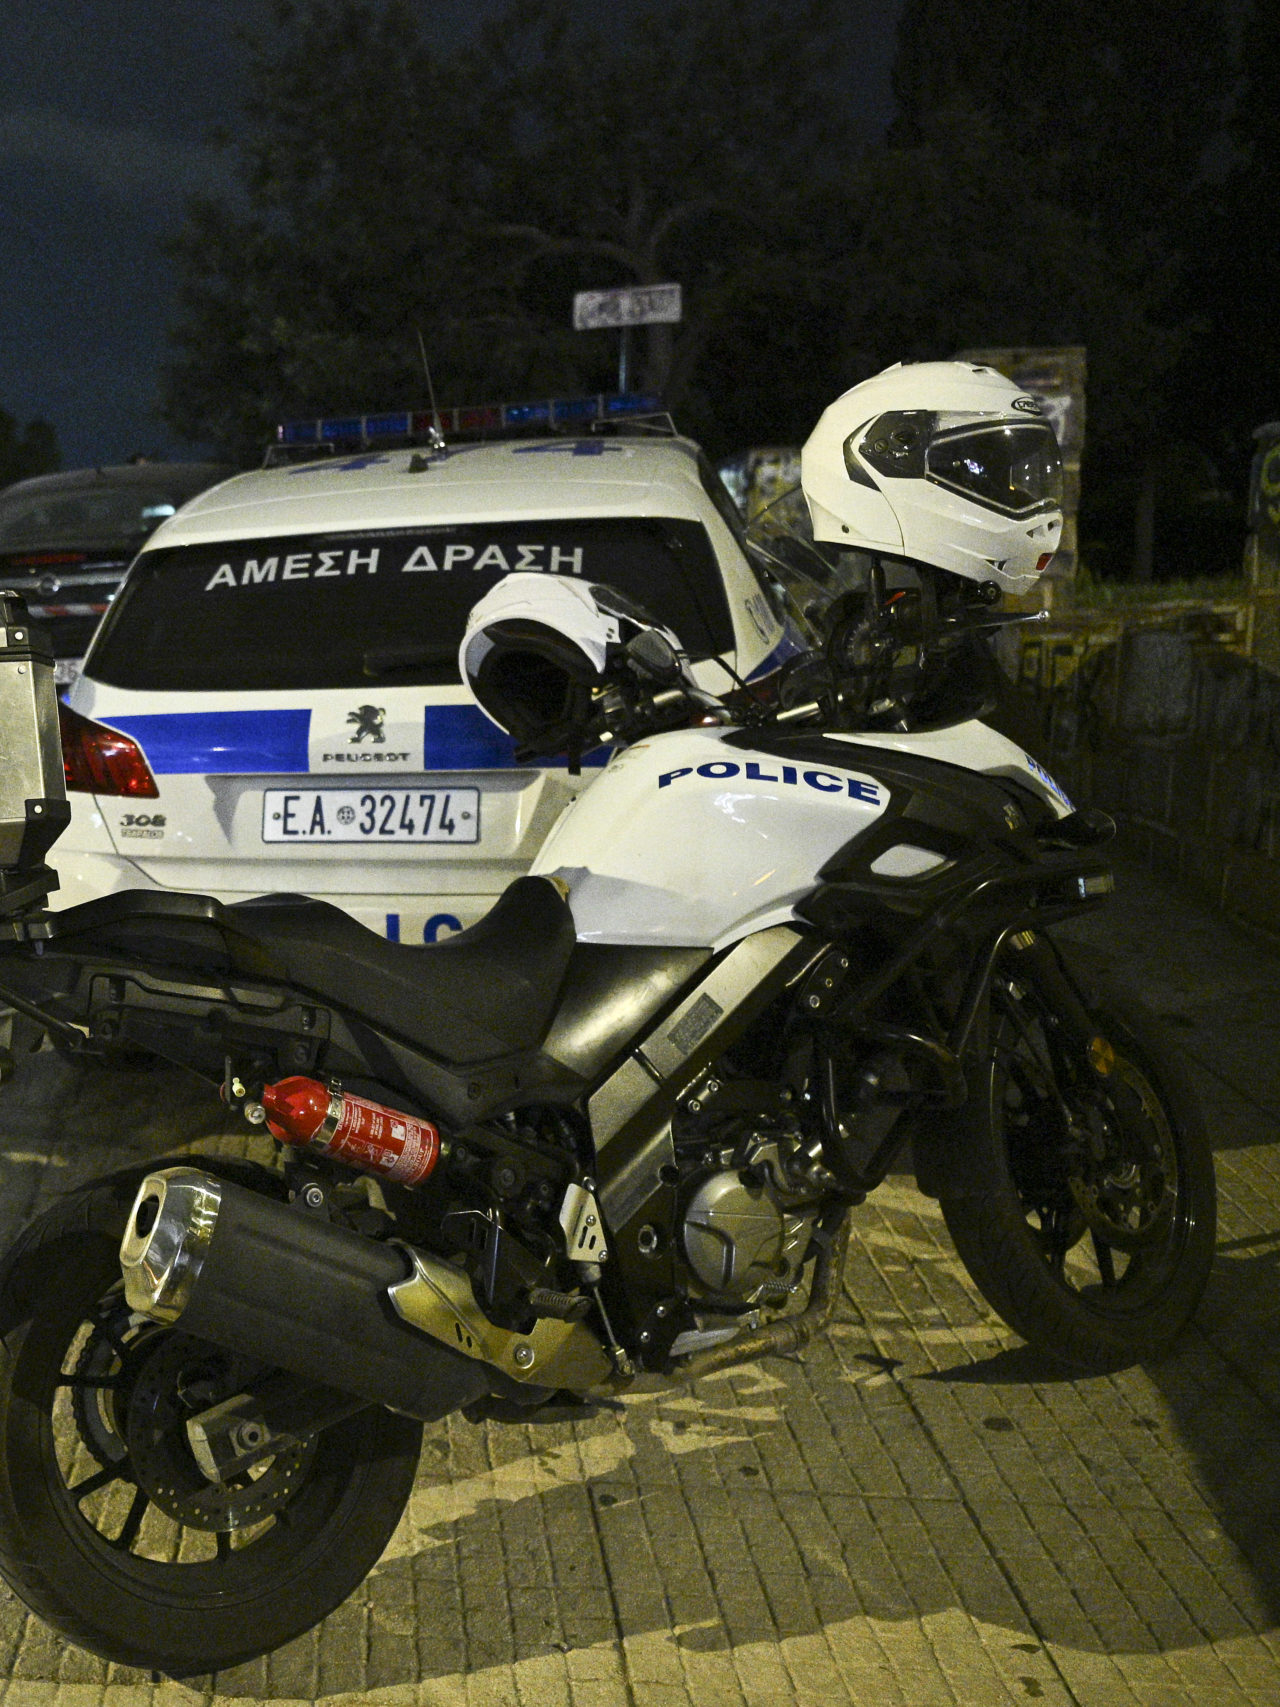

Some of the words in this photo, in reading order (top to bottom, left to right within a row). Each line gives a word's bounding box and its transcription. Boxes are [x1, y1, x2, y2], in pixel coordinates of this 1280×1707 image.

[204, 548, 381, 591] ΑΜΕΣΗ
[401, 544, 584, 574] ΔΡΑΣΗ
[322, 752, 411, 763] PEUGEOT
[658, 761, 881, 807] POLICE
[359, 794, 456, 836] 32474
